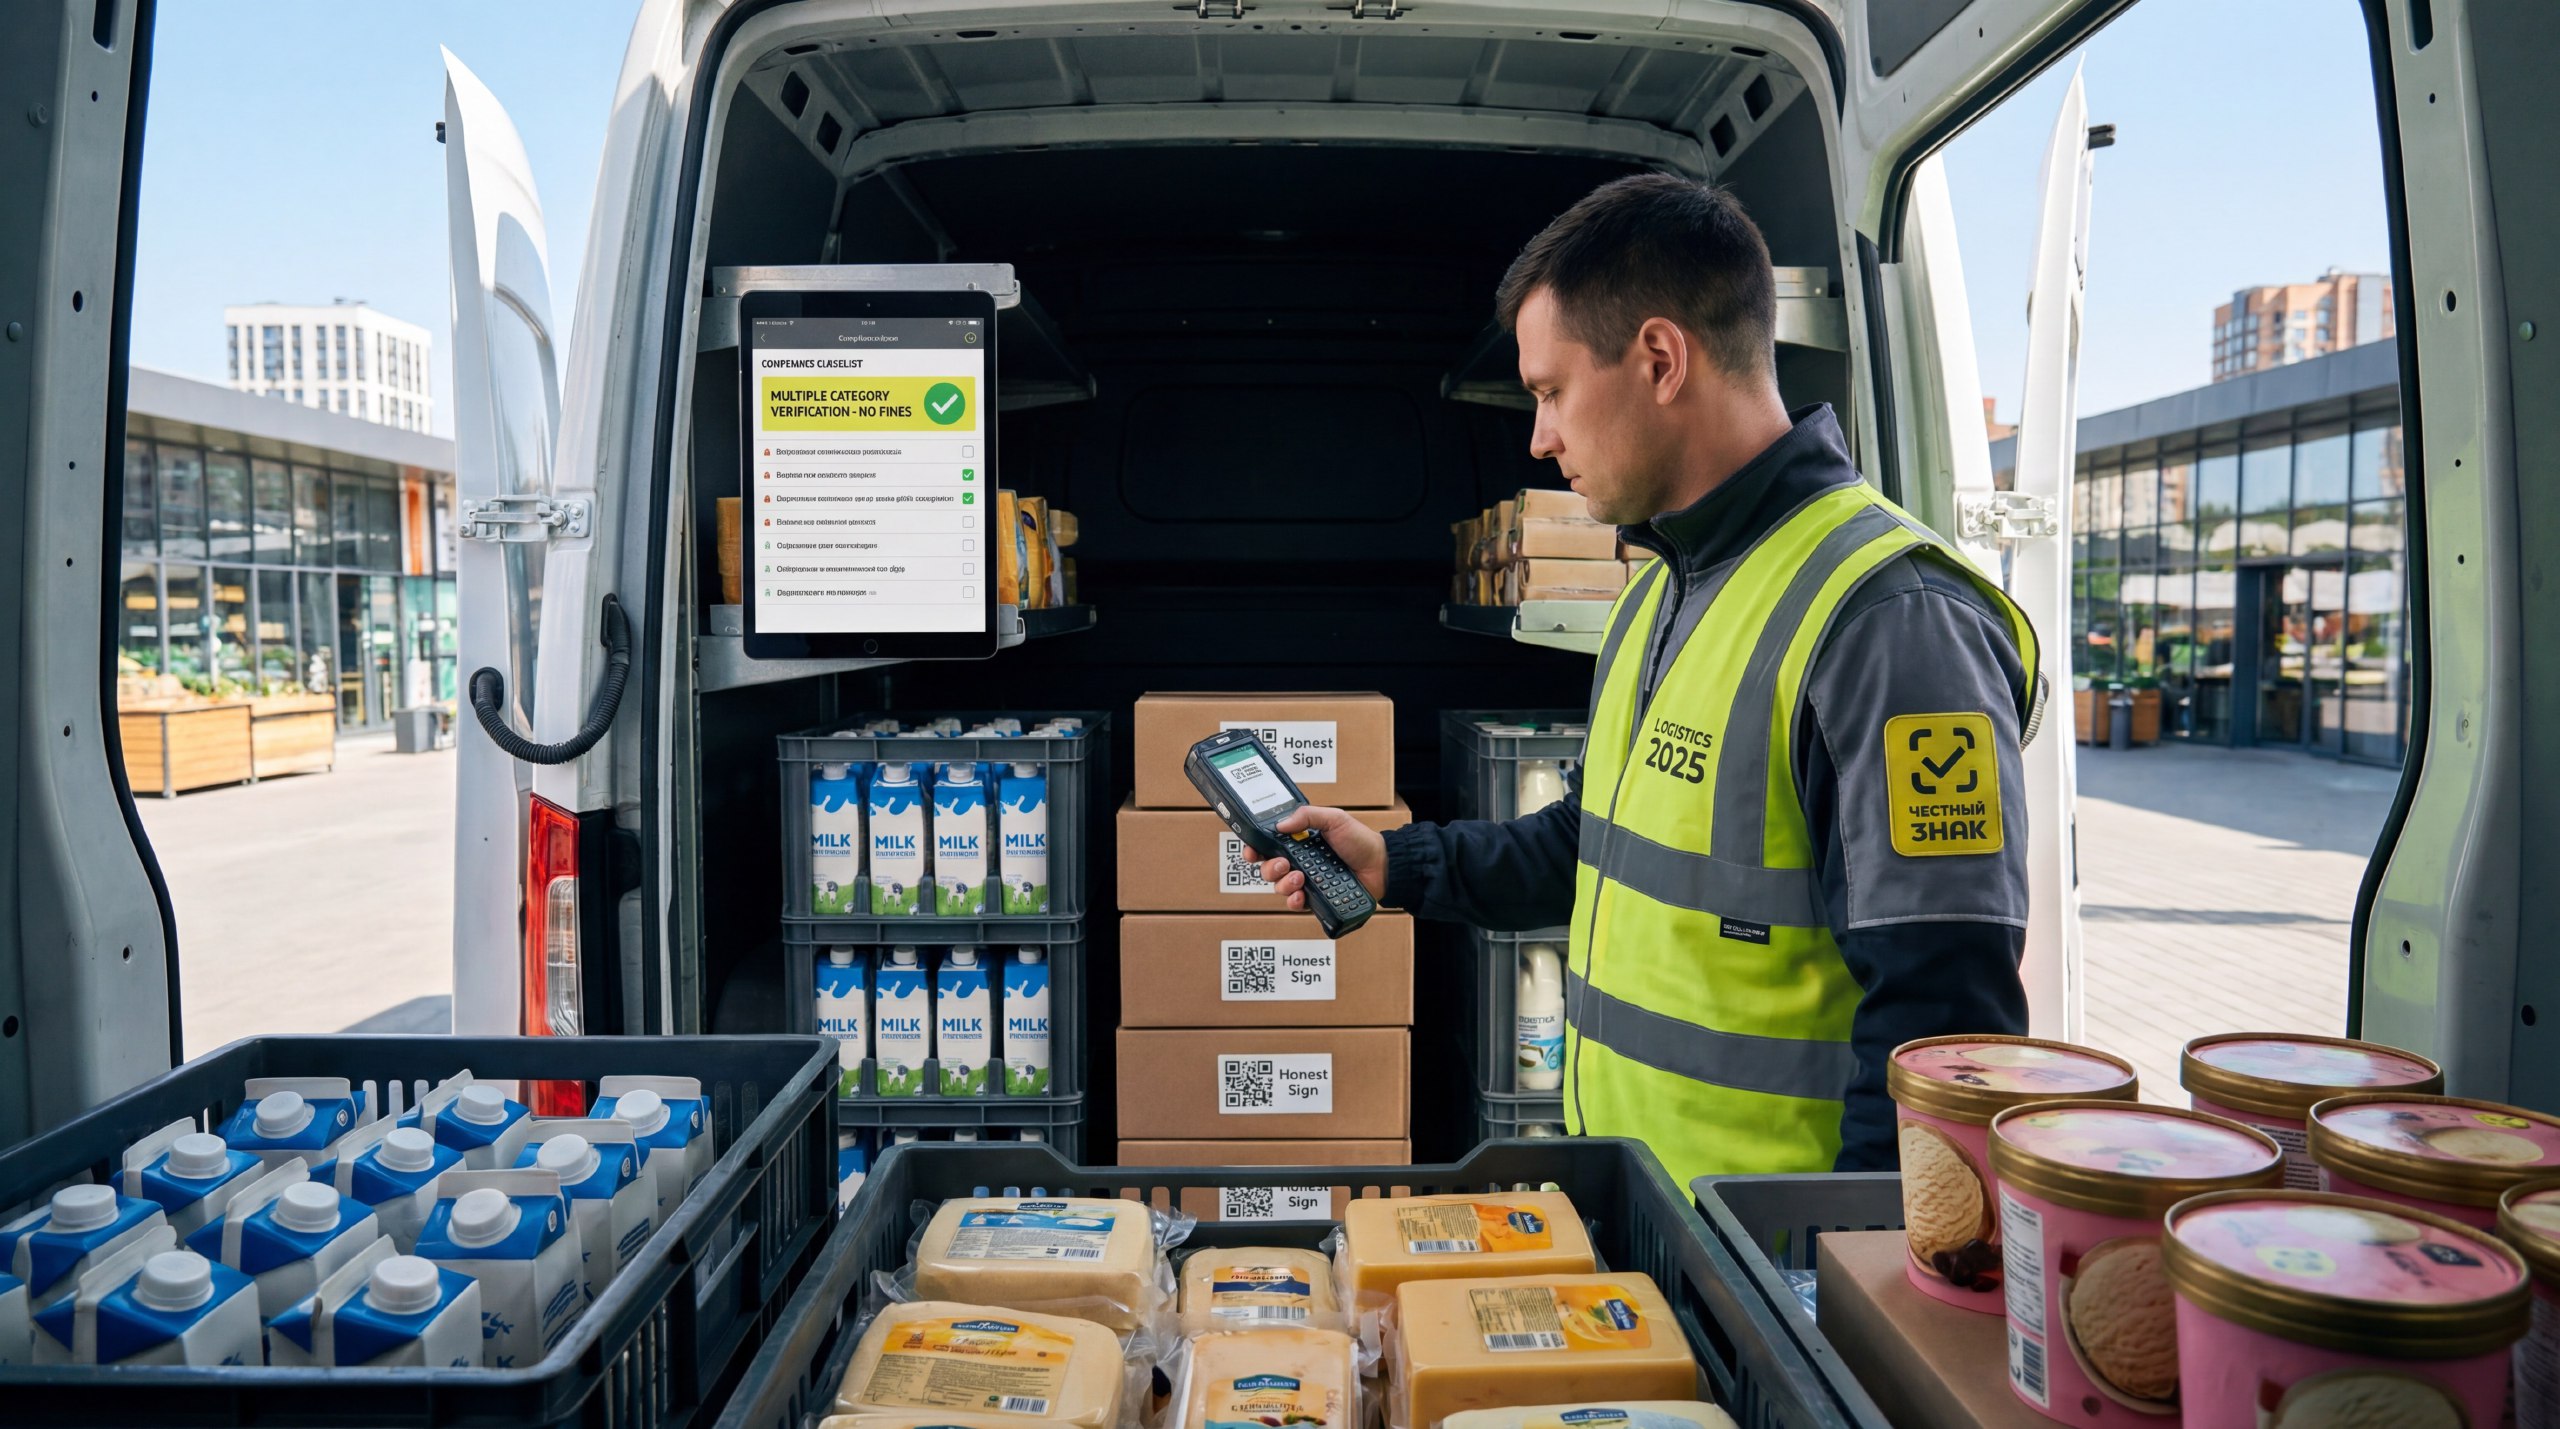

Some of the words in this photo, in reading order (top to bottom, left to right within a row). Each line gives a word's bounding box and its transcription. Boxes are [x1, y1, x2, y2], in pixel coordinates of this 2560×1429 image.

[770, 390, 827, 402] MULTIPLE
[830, 390, 890, 402] CATEGORY
[770, 406, 850, 418] VERIFICATION
[858, 406, 877, 418] NO
[879, 406, 912, 418] FINES
[1654, 717, 1713, 748] LOGISTICS
[1284, 736, 1333, 749] Honest
[1292, 752, 1323, 768] Sign
[1645, 737, 1707, 784] 2025
[1908, 800, 1986, 818] ЧЕСТНЫЙ
[1910, 820, 1988, 842] ЗНАК
[811, 833, 851, 847] MILK
[875, 835, 916, 849] MILK
[939, 835, 979, 849] MILK
[1005, 833, 1046, 847] MILK
[1282, 954, 1331, 967] Honest
[1290, 970, 1322, 986] Sign
[817, 1018, 858, 1032] MILK
[881, 1018, 921, 1032] MILK
[942, 1018, 983, 1032] MILK
[1009, 1018, 1049, 1032] MILK
[1279, 1068, 1328, 1081] Honest
[1288, 1084, 1319, 1100] Sign
[1288, 1195, 1318, 1210] Sign
